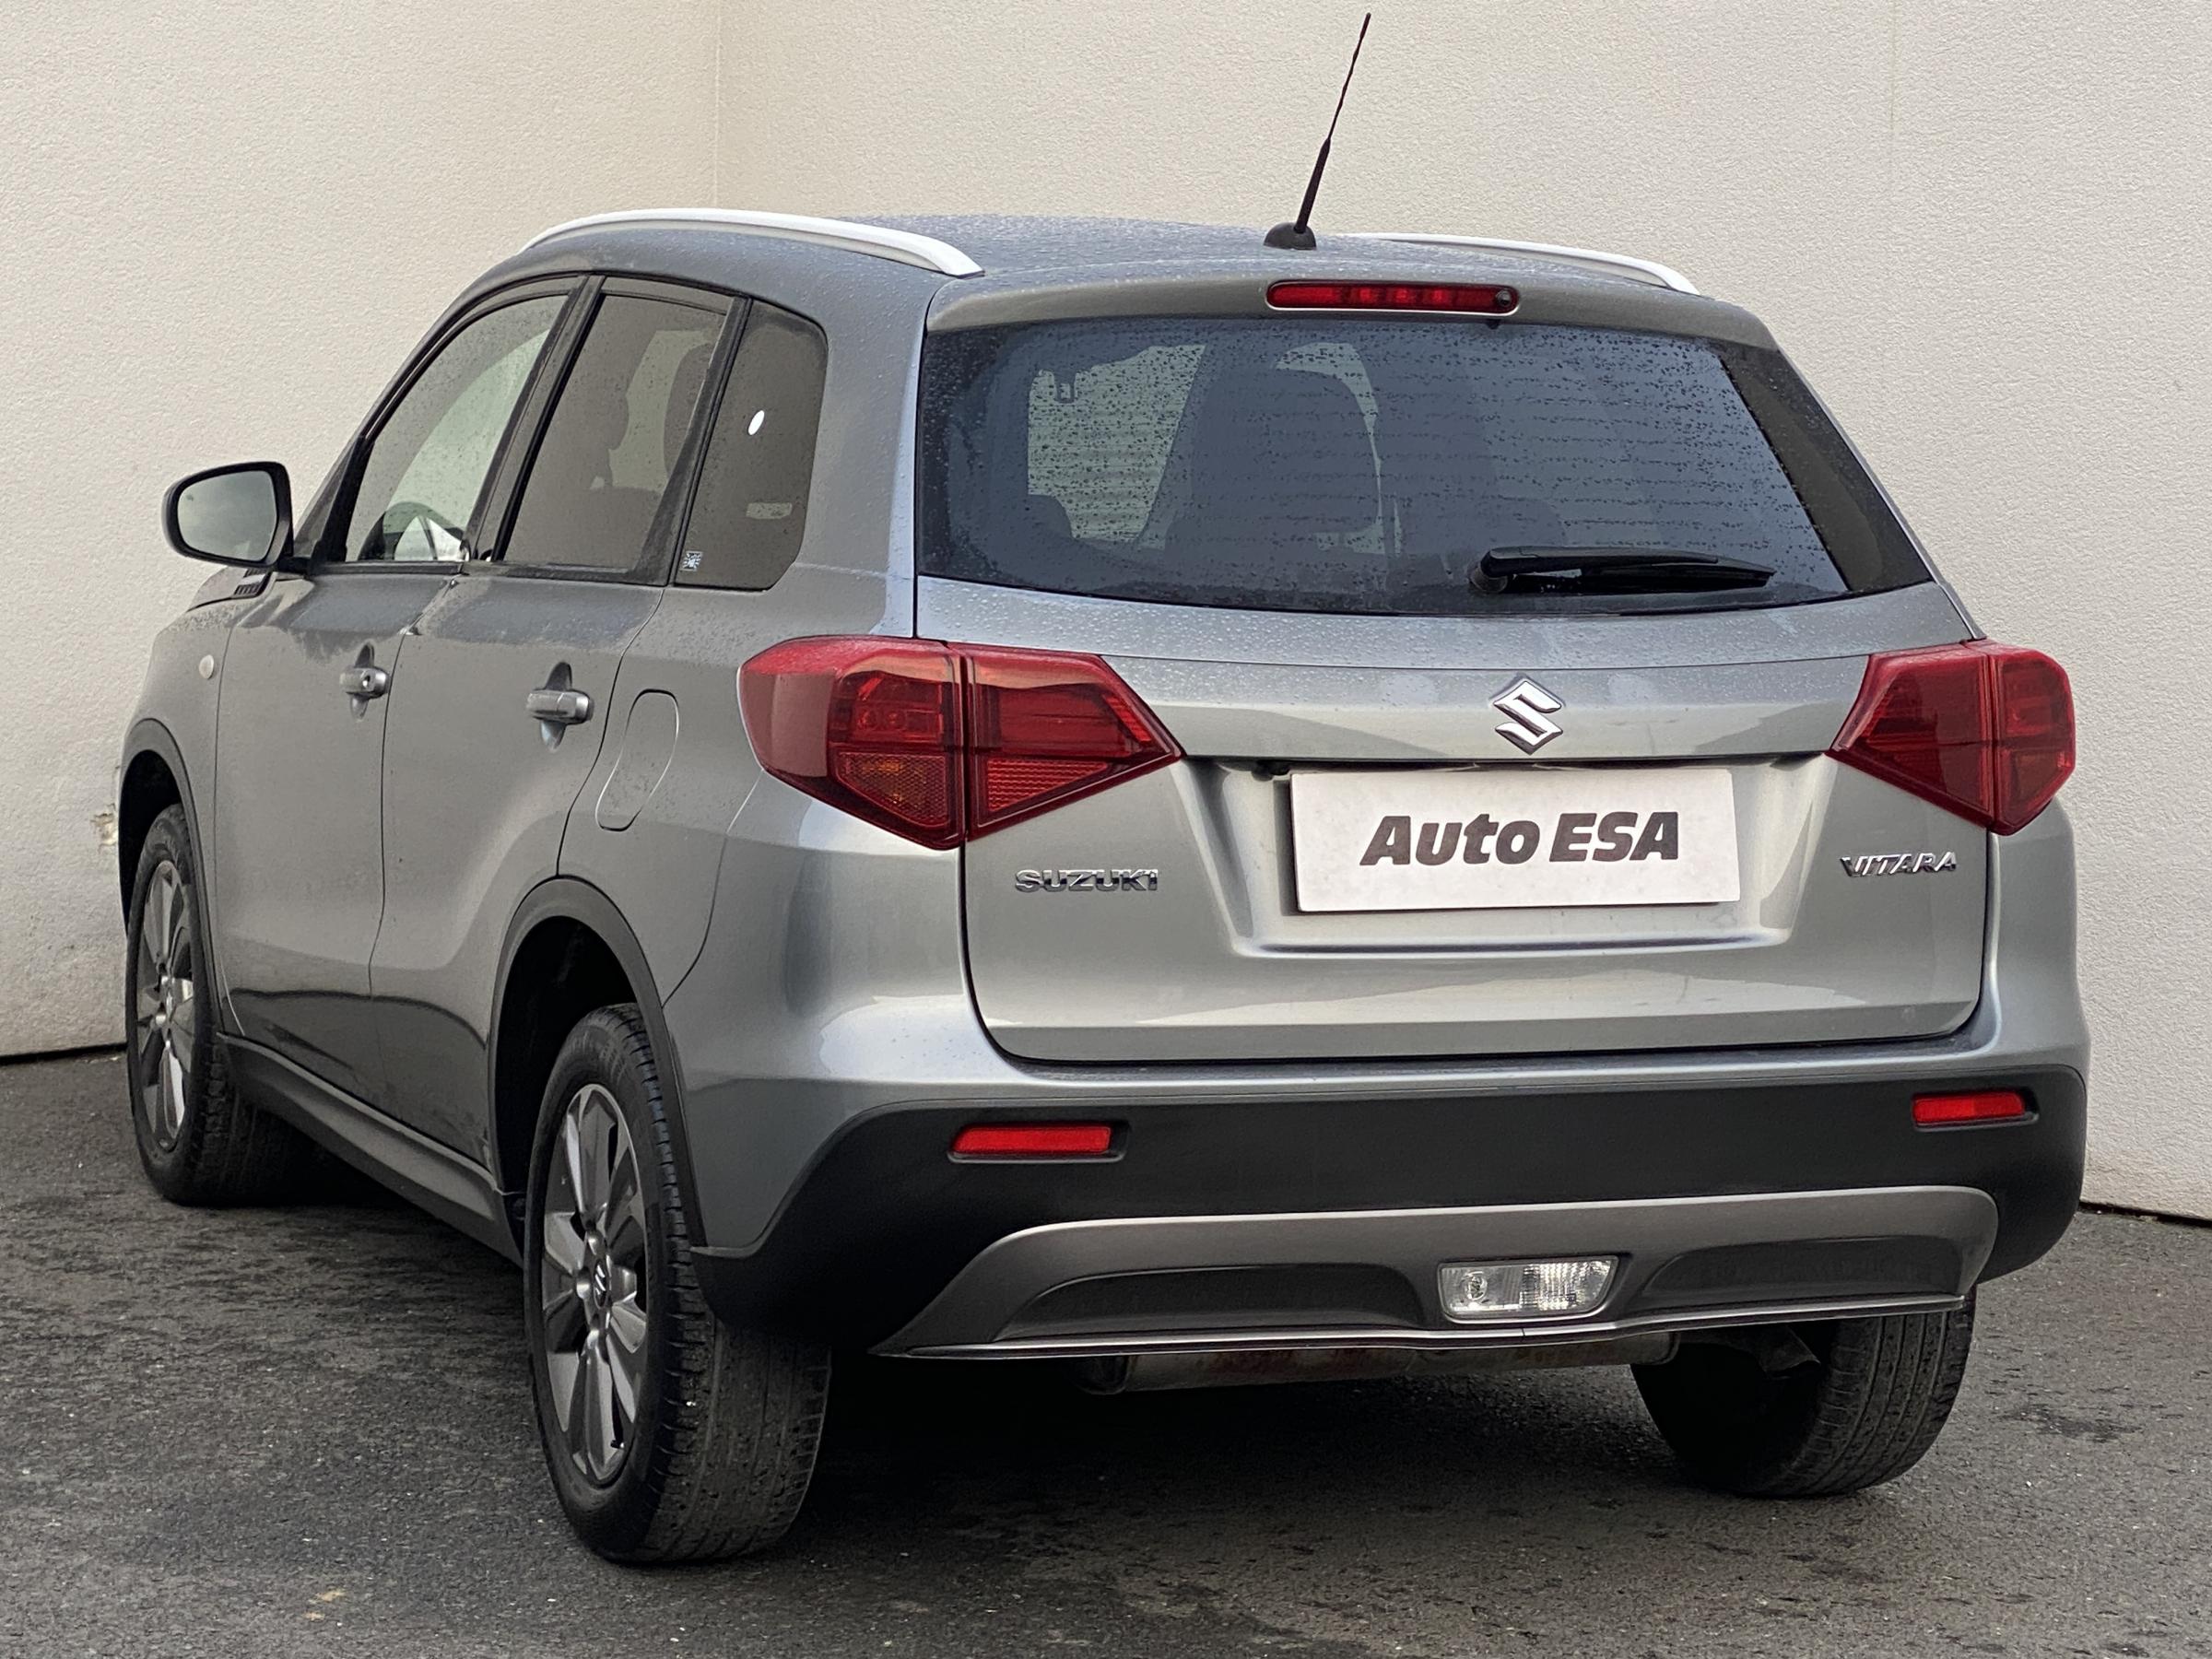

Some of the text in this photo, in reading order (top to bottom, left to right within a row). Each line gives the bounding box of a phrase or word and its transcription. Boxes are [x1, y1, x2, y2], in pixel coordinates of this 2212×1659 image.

[1359, 811, 1678, 865] Auto ESA
[1840, 851, 1958, 877] VITARA
[1016, 869, 1159, 893] SUZUKI
